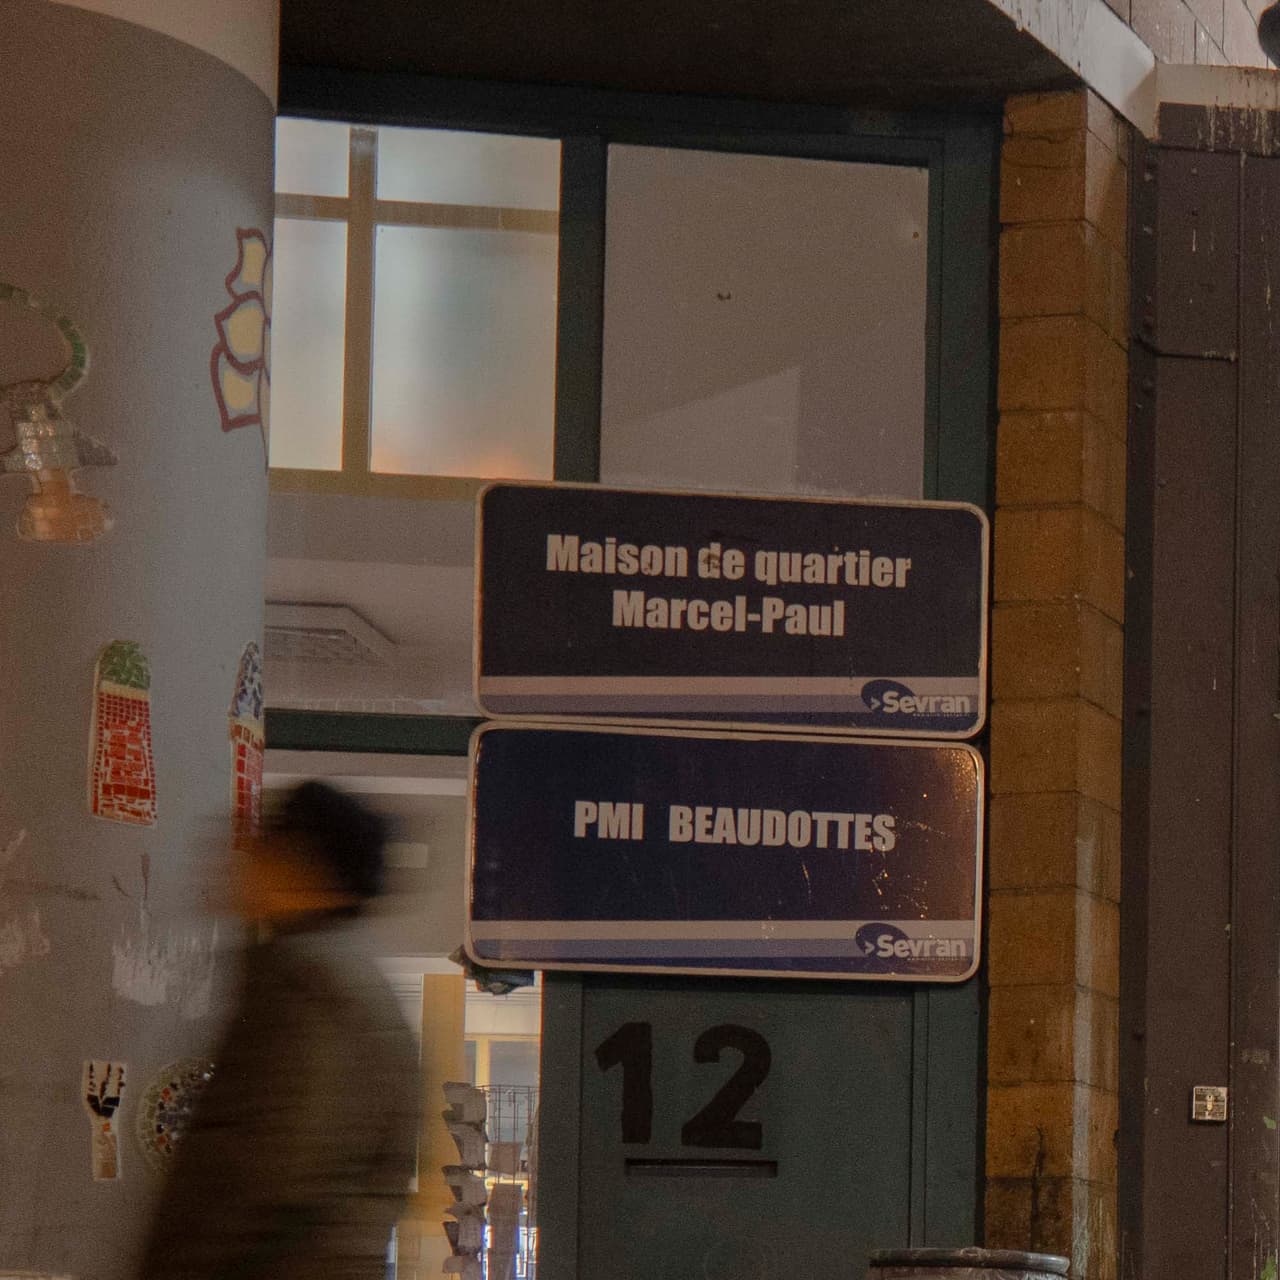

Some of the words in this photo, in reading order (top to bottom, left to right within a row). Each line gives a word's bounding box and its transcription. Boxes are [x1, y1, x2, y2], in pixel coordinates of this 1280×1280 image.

[545, 534, 688, 578] Maison
[697, 542, 746, 581] de
[754, 548, 912, 588] quartier
[612, 590, 845, 637] Marcel-Paul
[882, 690, 970, 713] Sevran
[574, 801, 643, 840] PMI
[668, 805, 896, 852] BEAUDOTTES
[876, 934, 966, 958] Sevran
[595, 1022, 772, 1150] 12
